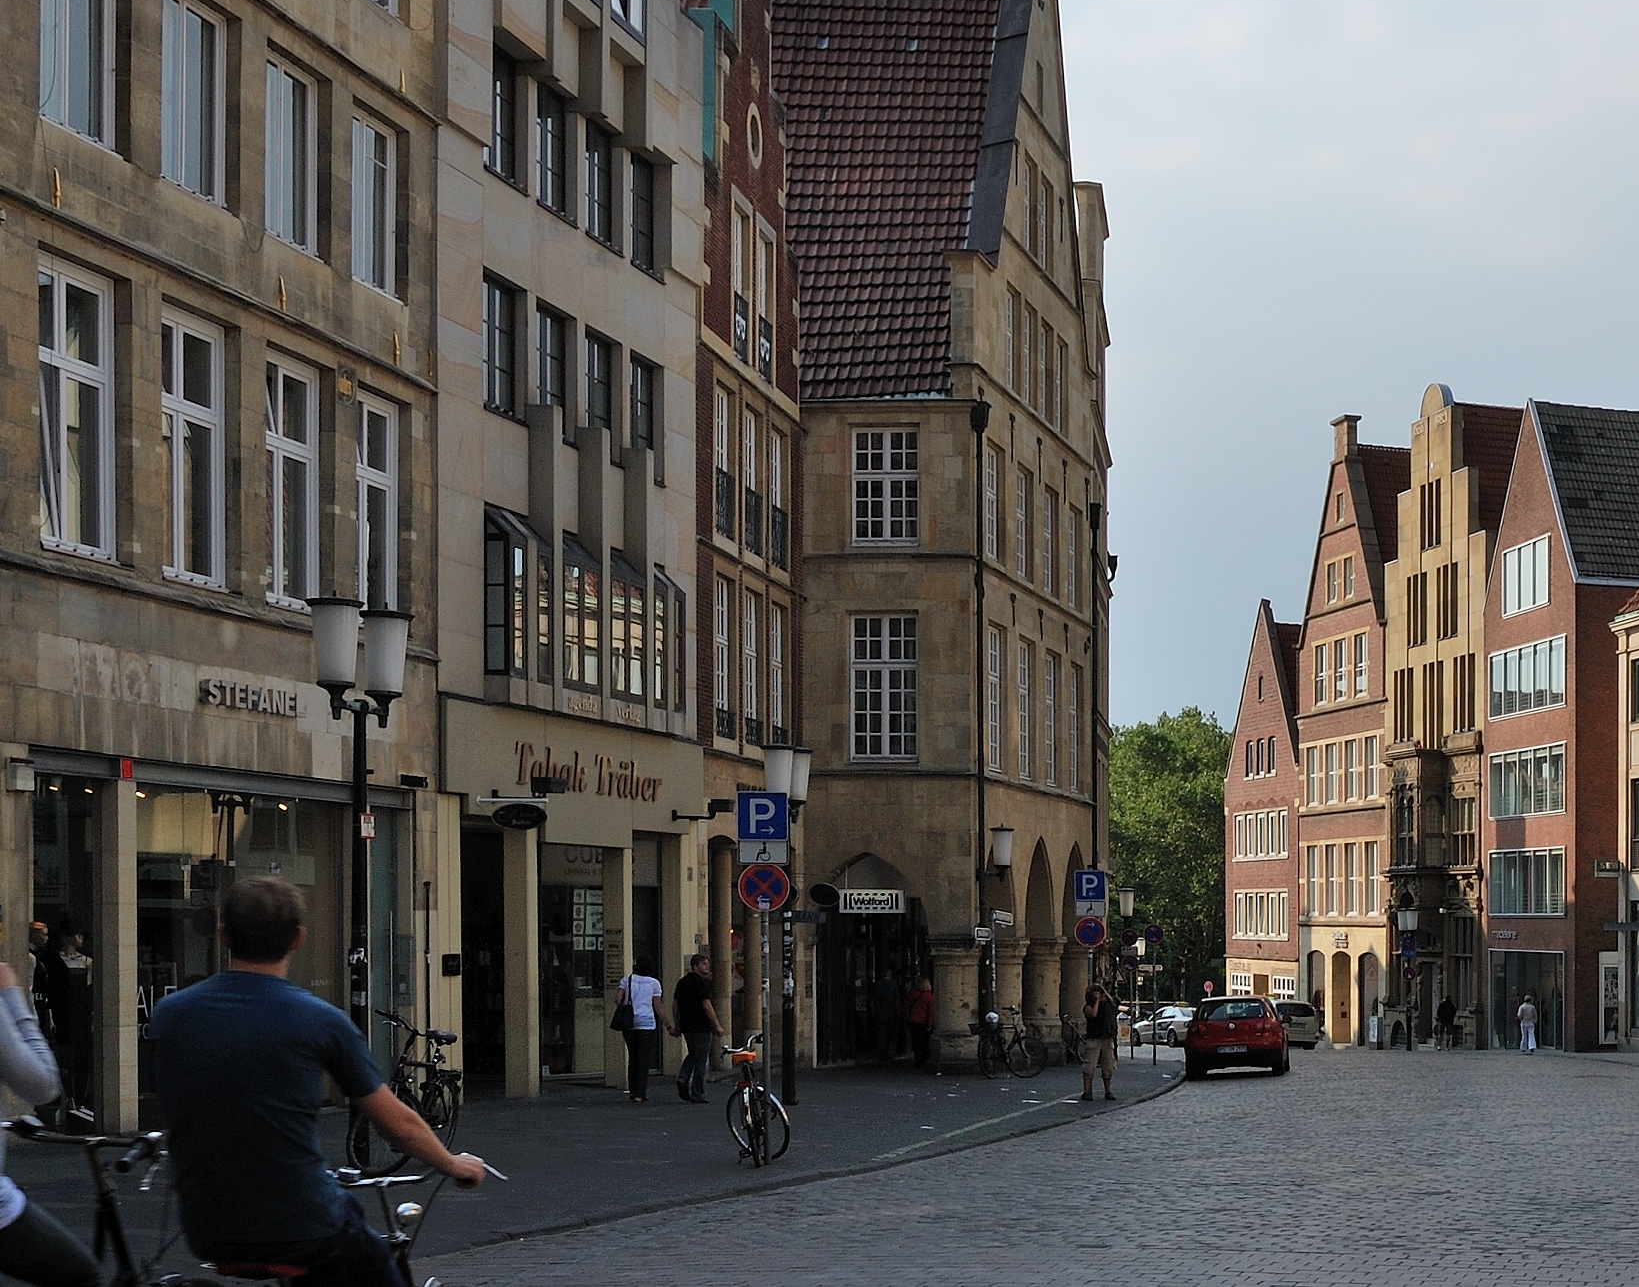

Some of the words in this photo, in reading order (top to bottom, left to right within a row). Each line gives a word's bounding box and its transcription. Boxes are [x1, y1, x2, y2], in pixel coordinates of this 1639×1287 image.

[595, 754, 663, 803] Träber
[750, 798, 776, 834] P
[1082, 875, 1098, 896] P
[852, 897, 890, 906] Wolford
